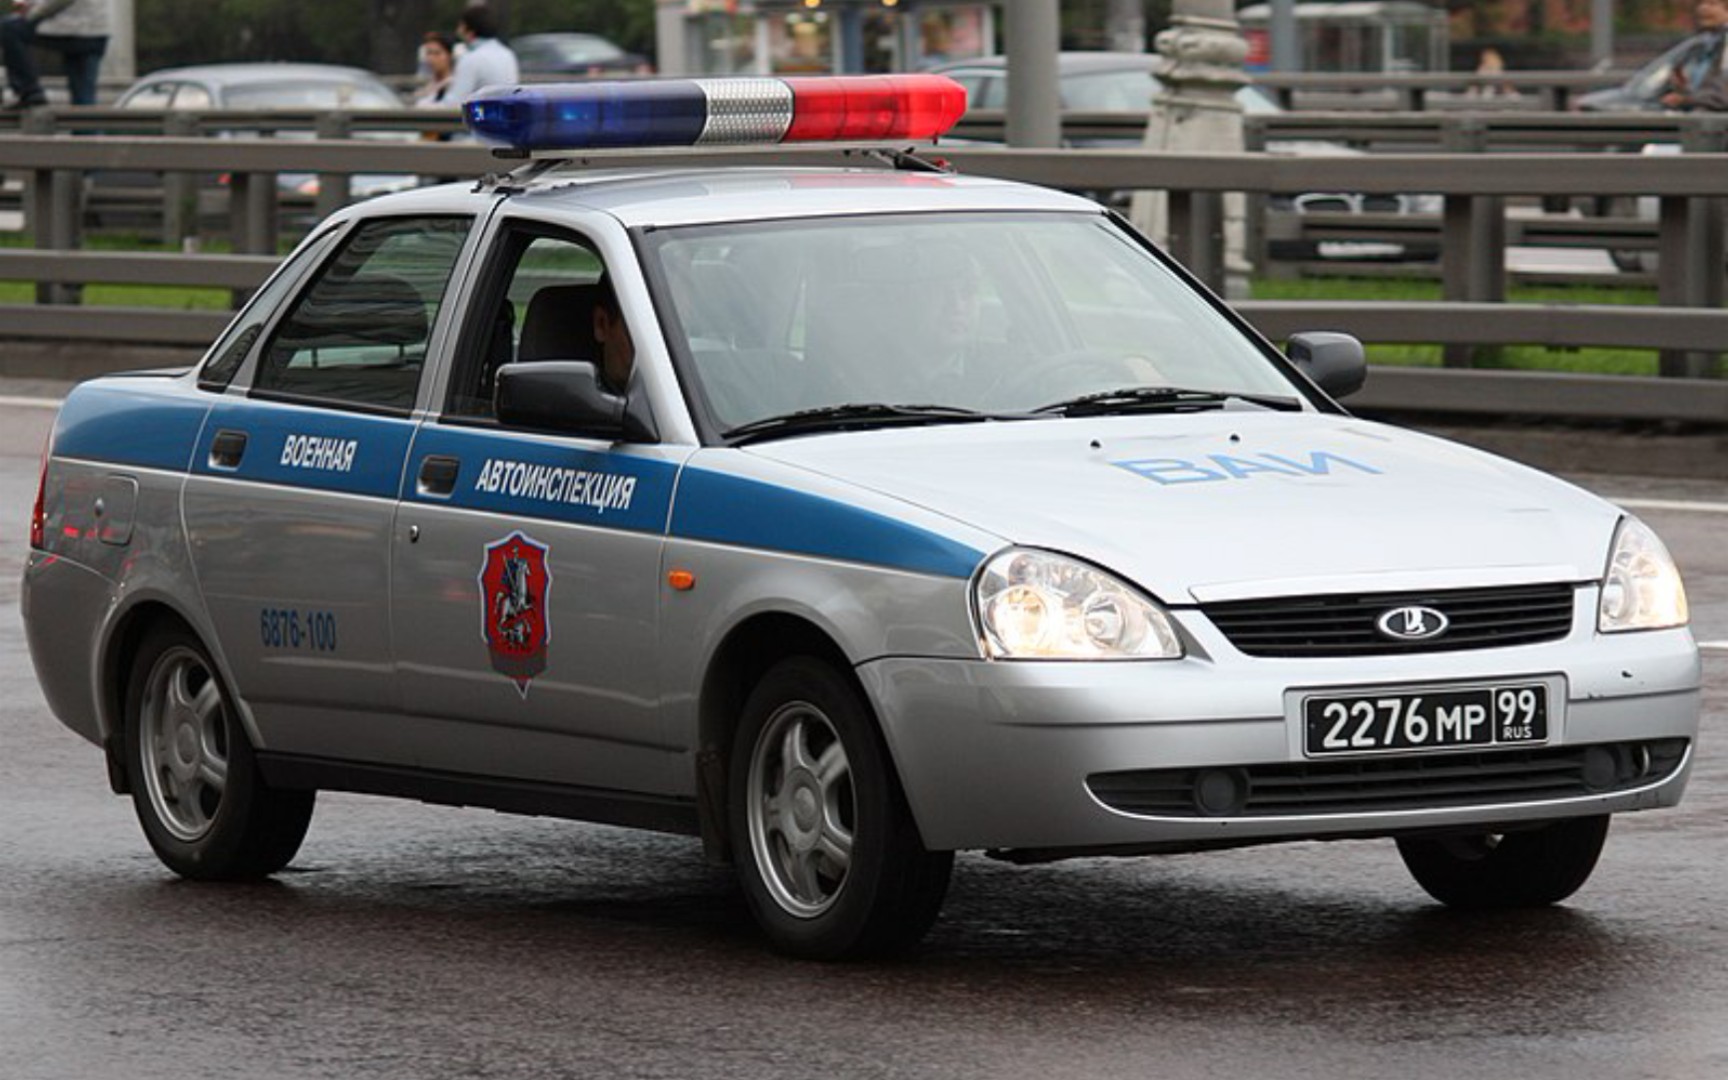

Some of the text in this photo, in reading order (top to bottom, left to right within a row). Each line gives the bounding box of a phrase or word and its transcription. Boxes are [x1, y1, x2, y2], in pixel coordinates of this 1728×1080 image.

[281, 434, 357, 472] ВОЕННАЯ
[1109, 452, 1383, 484] ВАИ
[474, 458, 637, 513] АВТОИНСПЕКЦИЯ
[261, 607, 336, 651] 6876-100
[1323, 690, 1537, 748] 2276 МР 99
[1503, 726, 1533, 739] RUS
